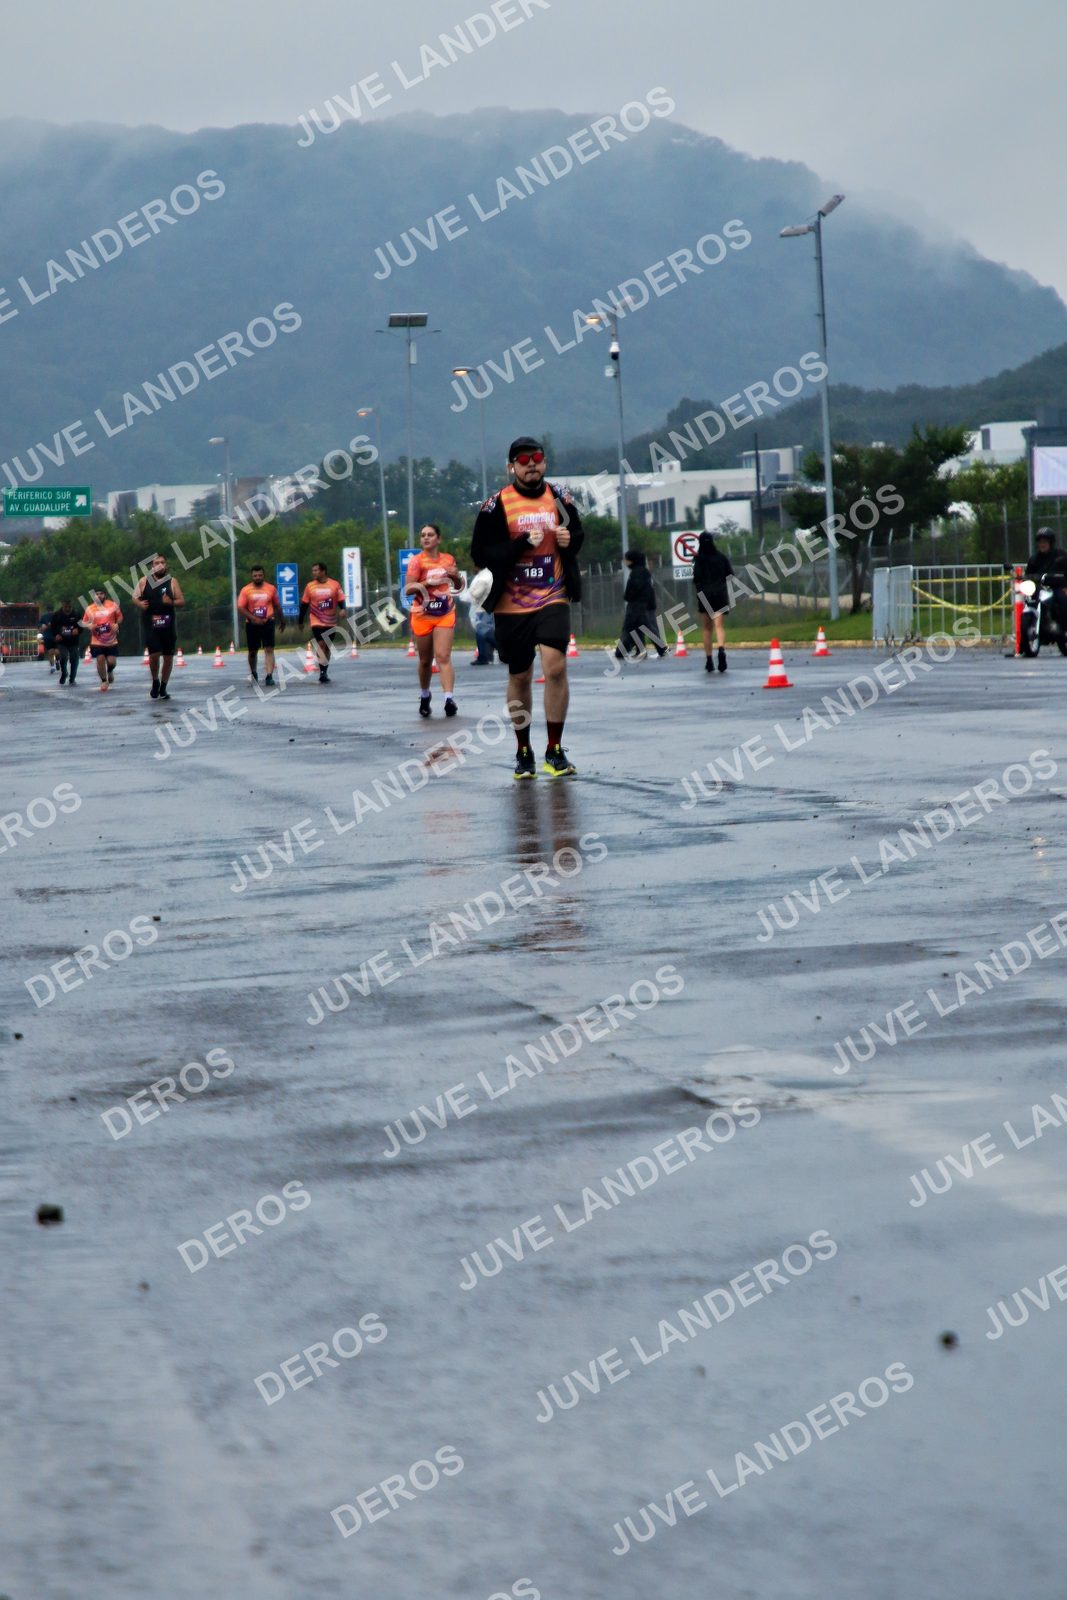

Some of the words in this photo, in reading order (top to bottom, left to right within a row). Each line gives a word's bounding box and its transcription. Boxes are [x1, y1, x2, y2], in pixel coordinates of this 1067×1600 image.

[8, 491, 53, 499] PERIFERICO
[56, 491, 71, 499] SUR
[23, 503, 71, 512] GUADALUPE
[524, 567, 544, 577] 183
[281, 586, 295, 605] E
